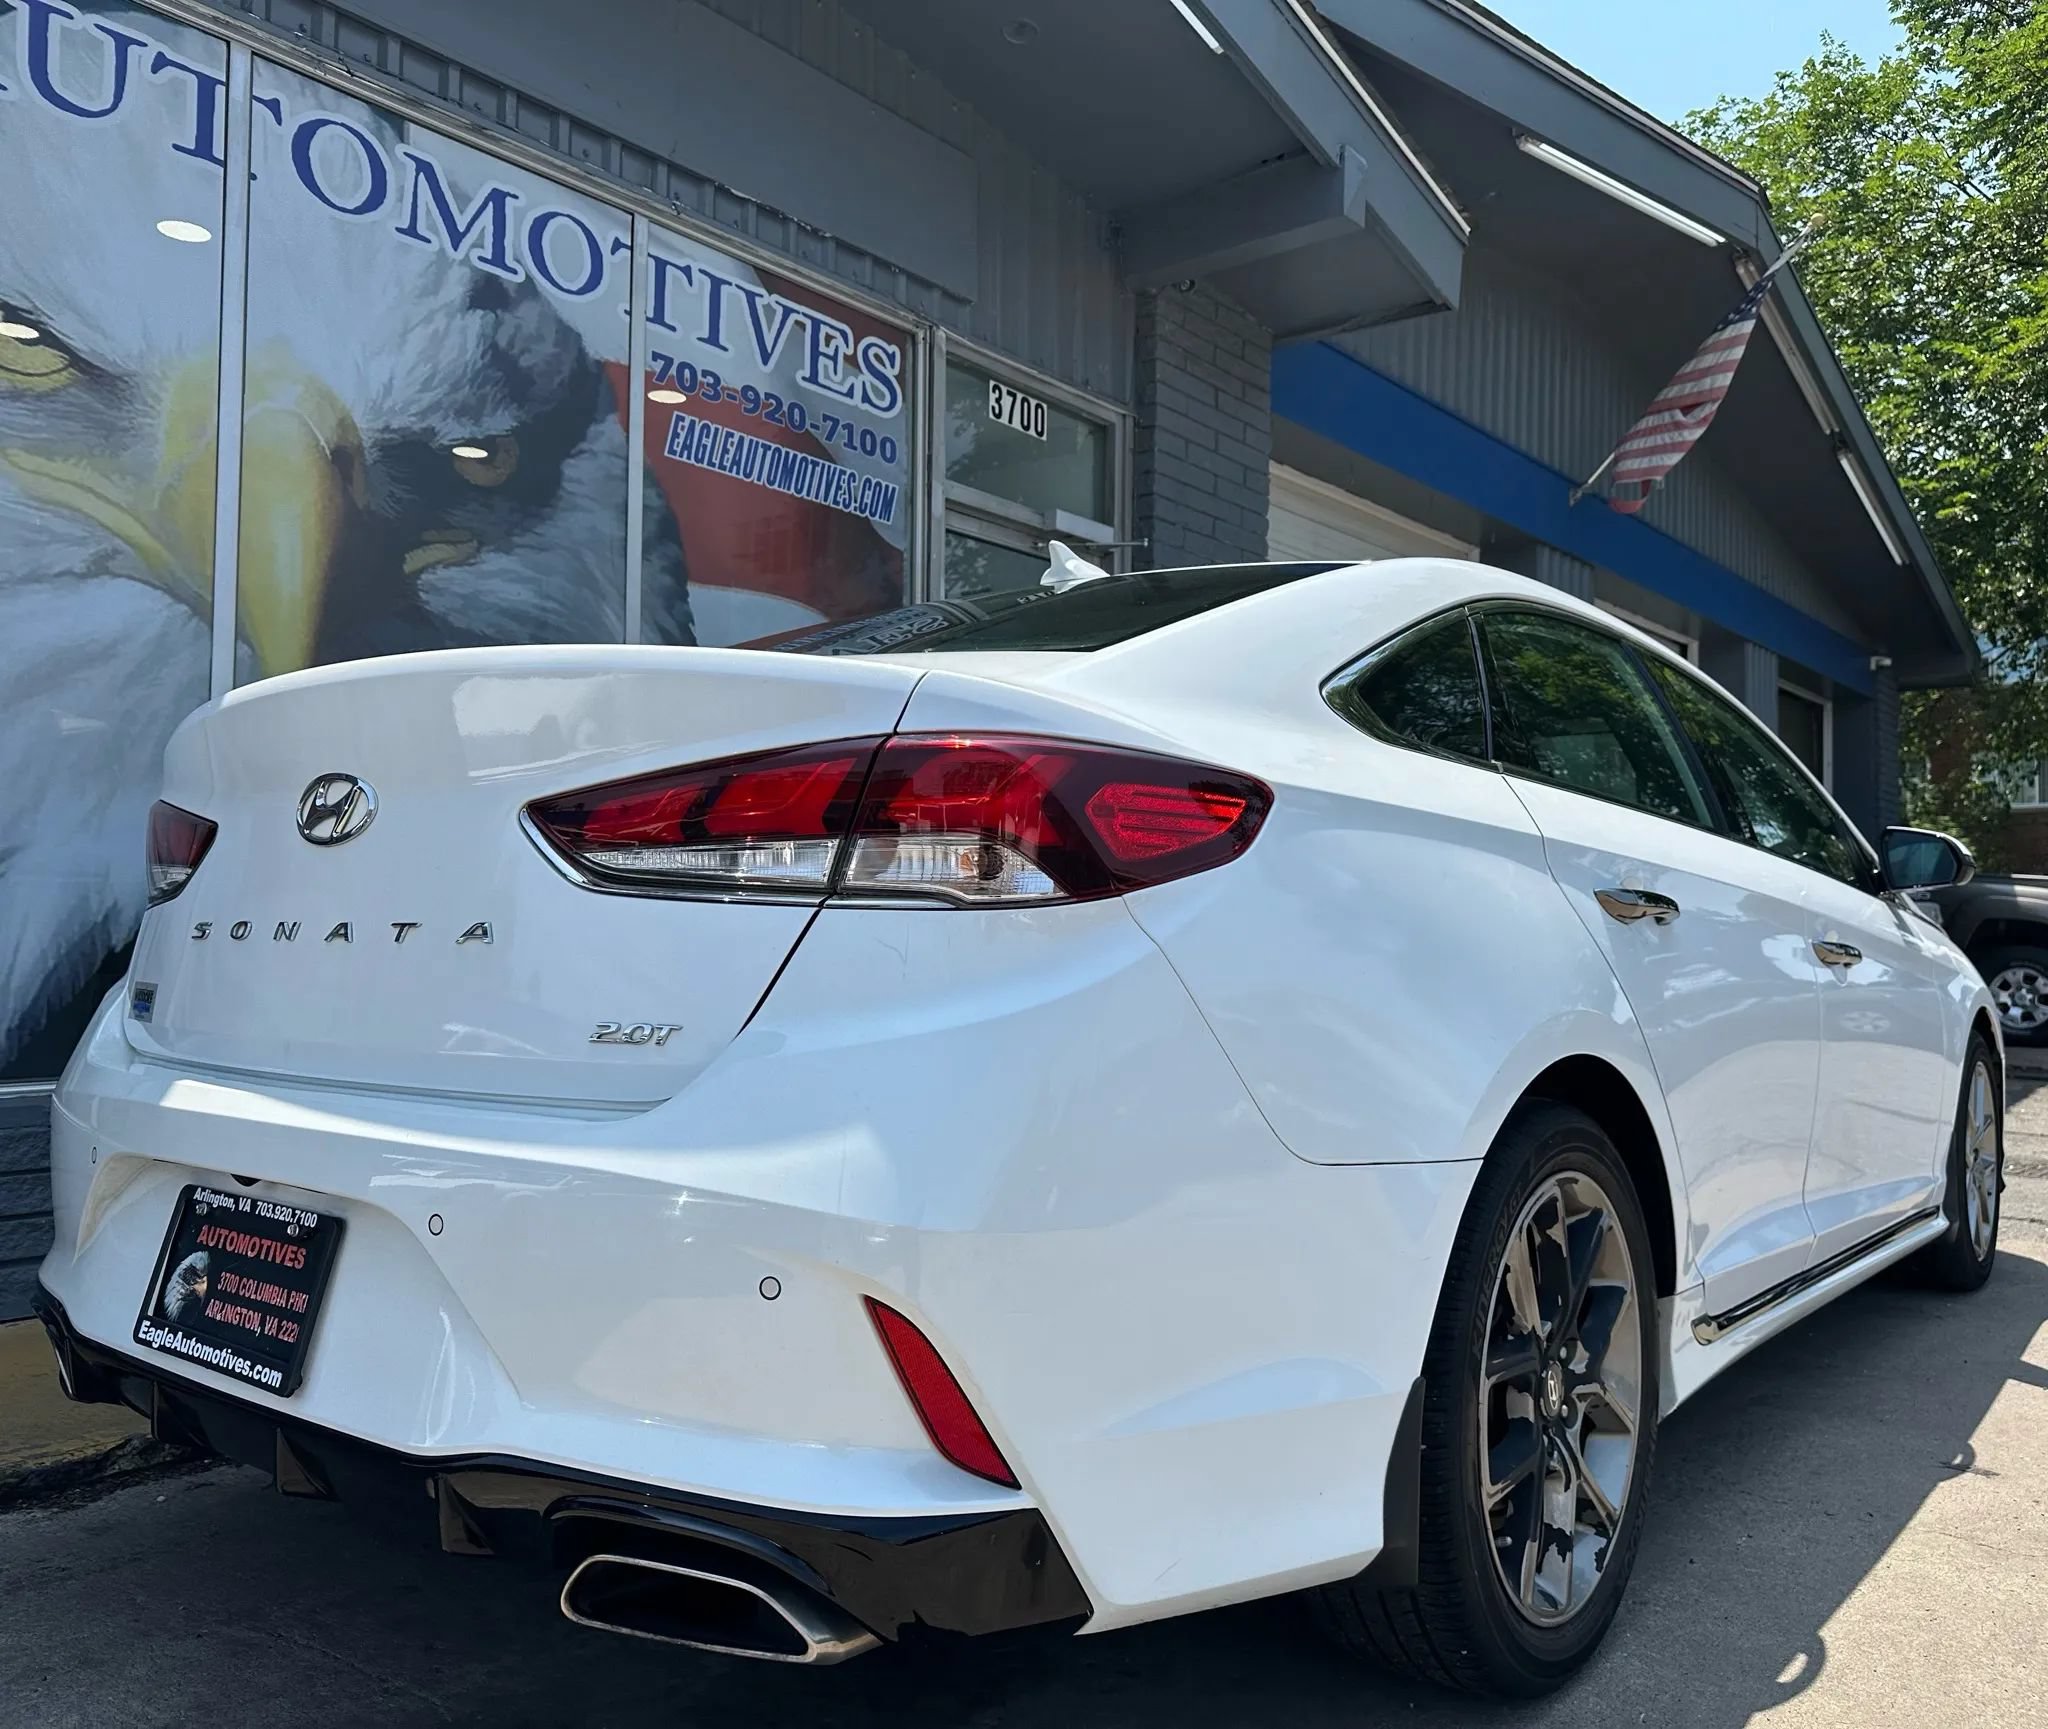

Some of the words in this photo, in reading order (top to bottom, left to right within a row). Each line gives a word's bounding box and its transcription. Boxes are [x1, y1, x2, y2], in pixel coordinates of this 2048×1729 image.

[0, 0, 898, 413] UTOMOTIVES
[651, 350, 897, 464] 703-920-7100
[991, 383, 1045, 438] 3700
[665, 412, 898, 523] EAGLEAUTOMOTIVES.COM
[191, 920, 494, 944] SONATA
[193, 1187, 236, 1212] Arlington,
[238, 1196, 252, 1213] VA
[255, 1201, 318, 1228] 703.920.7100
[197, 1224, 306, 1270] AUTOMOTIVES
[217, 1271, 240, 1294] 3700
[239, 1277, 288, 1308] COLUMBIA
[204, 1298, 262, 1337] ARLINGTON,
[264, 1314, 279, 1337] VA
[137, 1320, 283, 1388] EagleAutomotives.com
